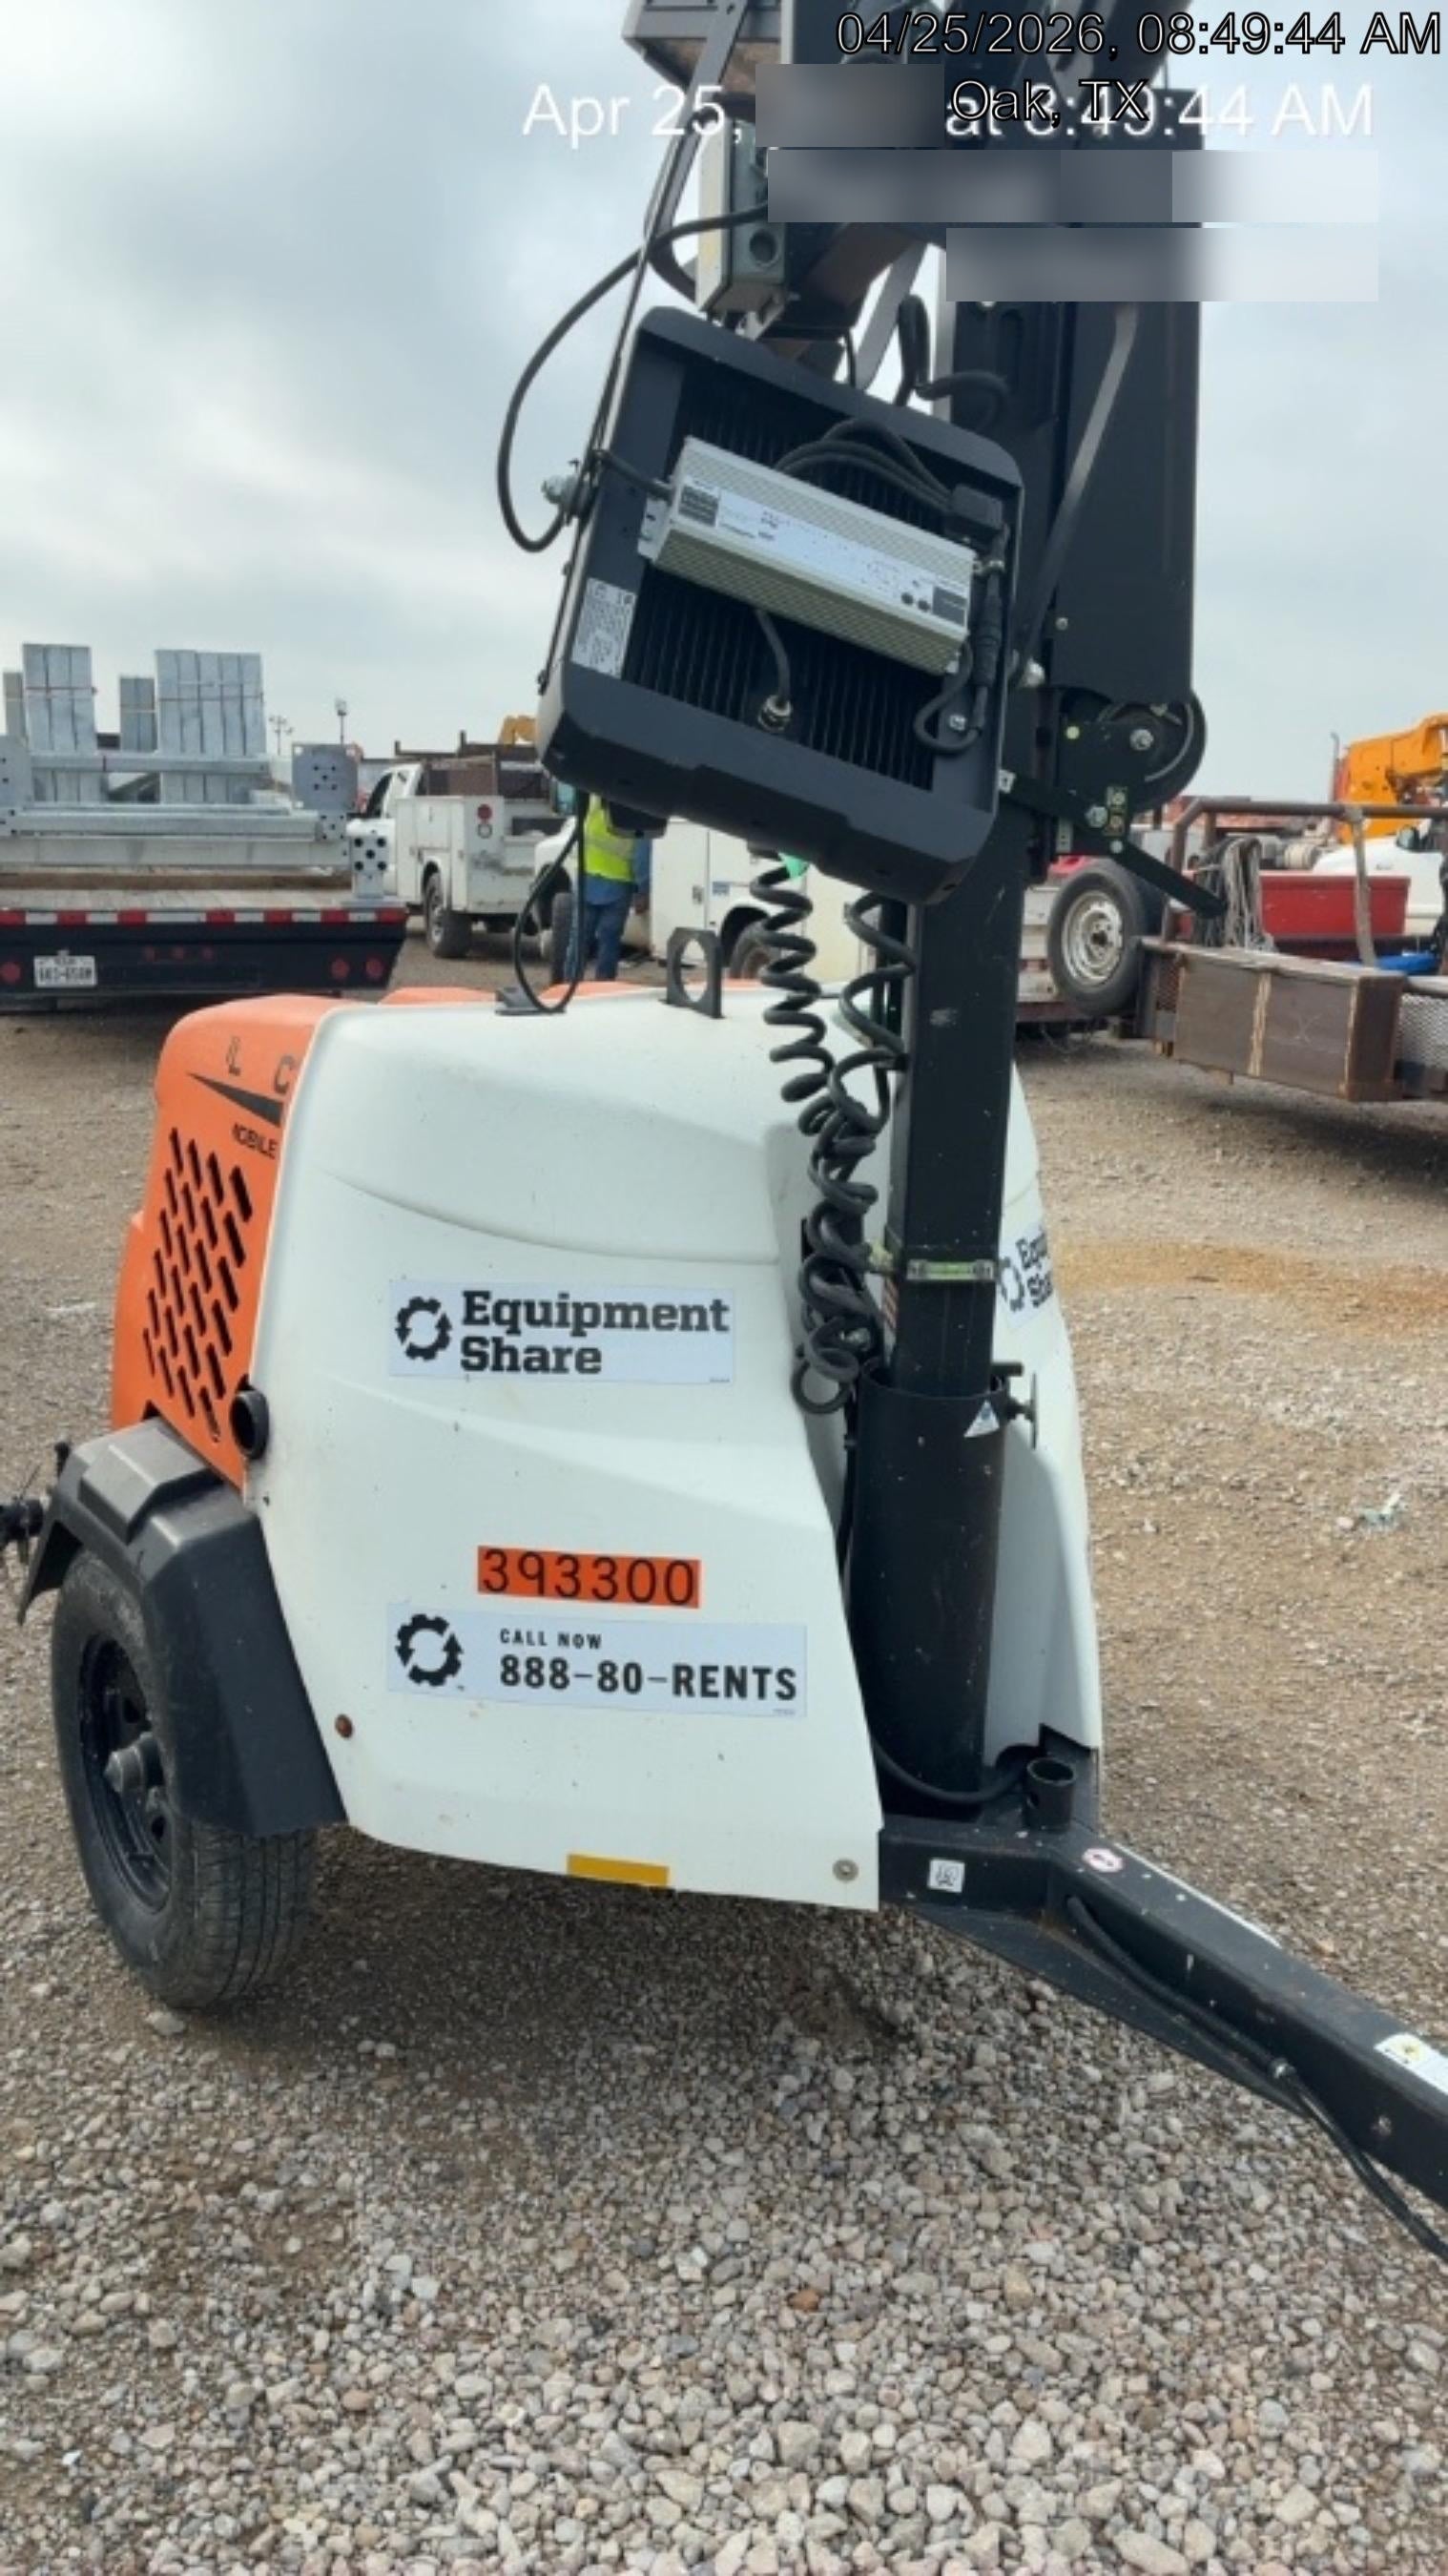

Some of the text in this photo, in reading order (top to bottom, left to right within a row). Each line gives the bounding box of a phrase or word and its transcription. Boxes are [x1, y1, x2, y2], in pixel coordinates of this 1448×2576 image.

[462, 1290, 730, 1337] Equipment
[460, 1336, 603, 1374] Share
[483, 1548, 694, 1606] 393300
[500, 1628, 602, 1650] CALL NOW
[500, 1654, 797, 1701] 888-80-RENTS
